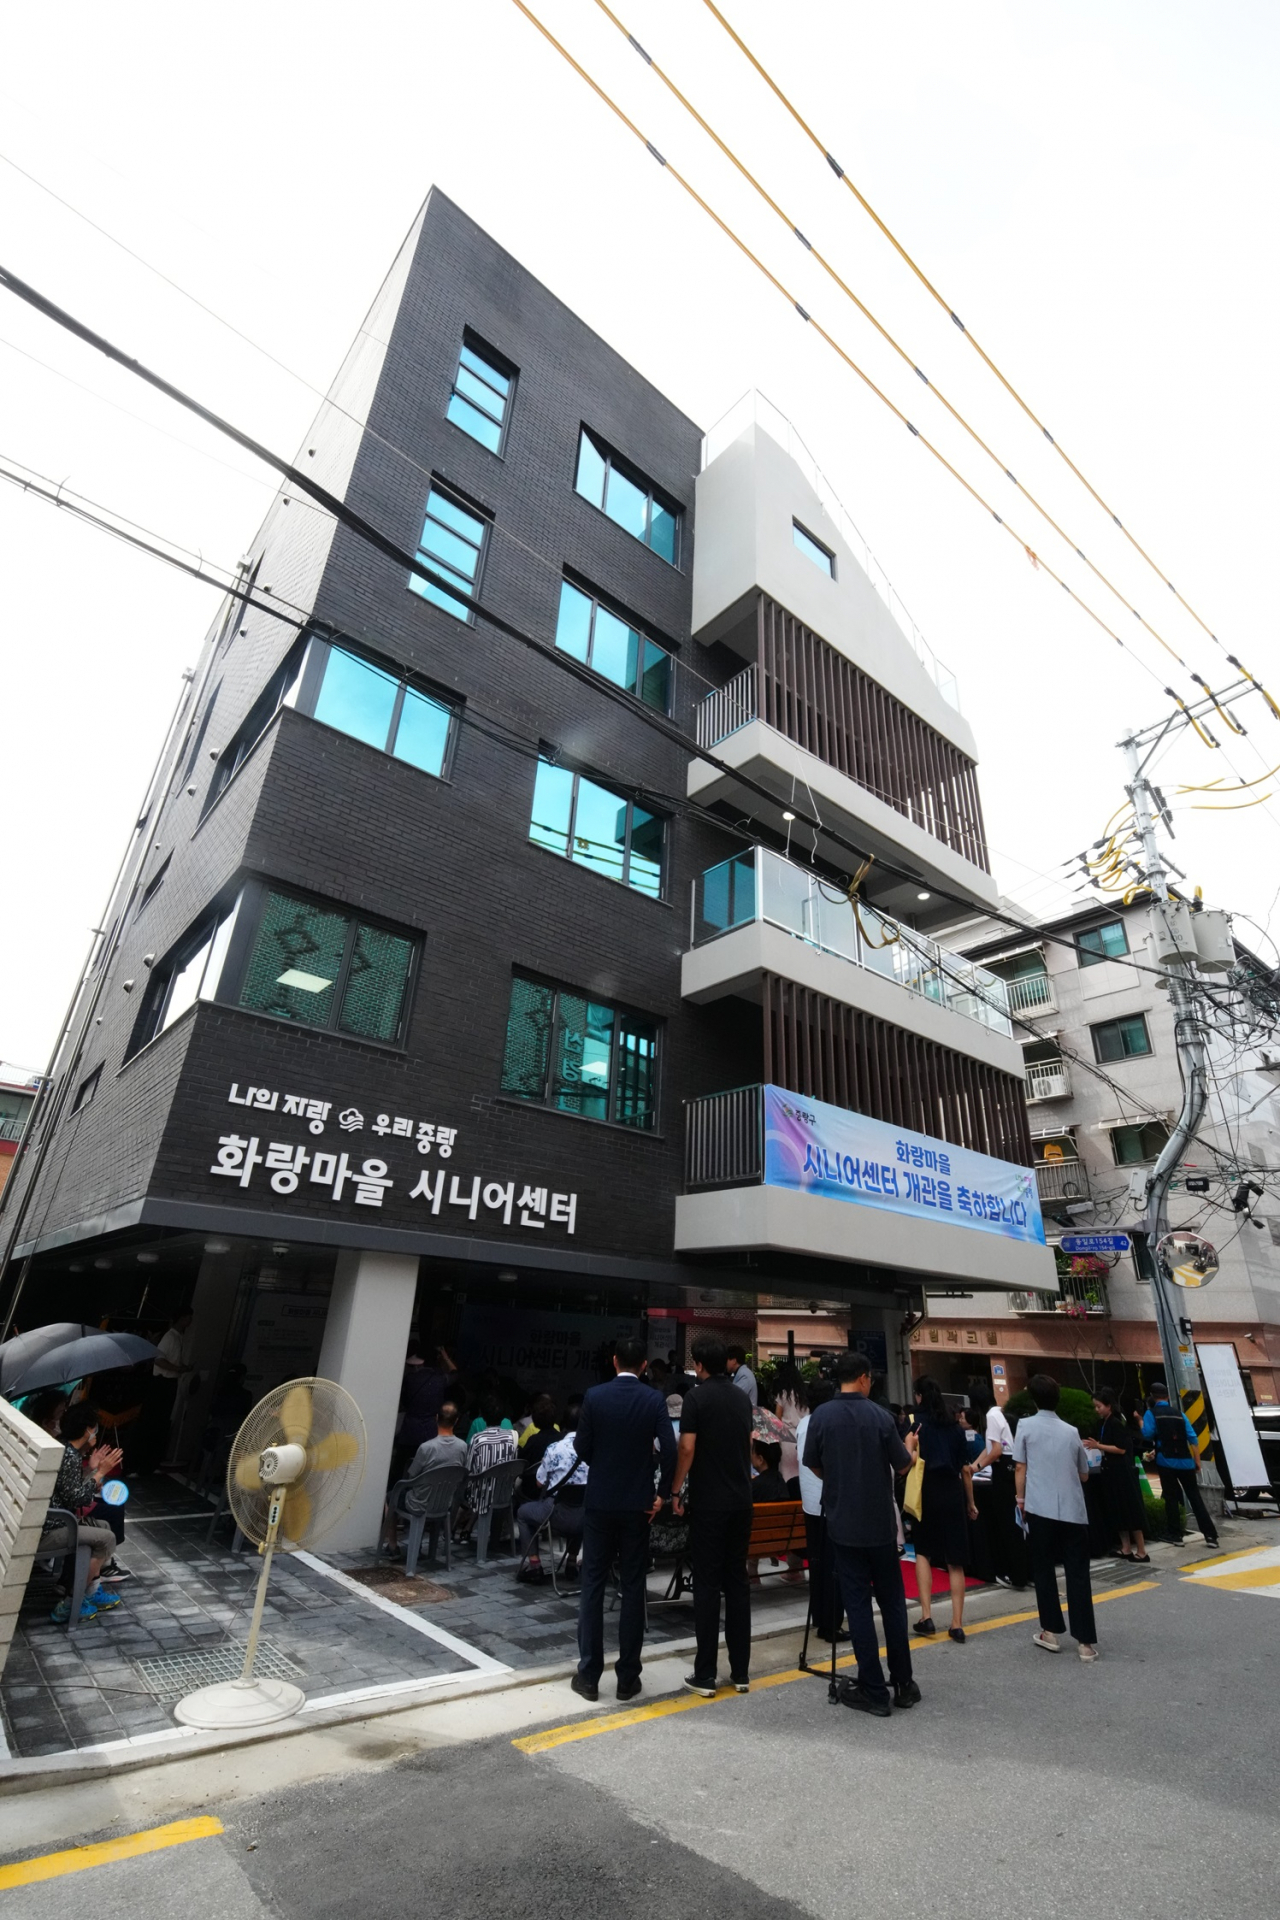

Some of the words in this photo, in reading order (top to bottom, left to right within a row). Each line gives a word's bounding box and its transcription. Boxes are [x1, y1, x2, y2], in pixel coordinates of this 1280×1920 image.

[227, 1083, 279, 1111] 나의
[281, 1093, 333, 1135] 자랑
[795, 1109, 816, 1126] 중랑구
[371, 1113, 413, 1138] 우리
[415, 1121, 458, 1158] 중랑
[895, 1139, 951, 1176] 화랑마을
[210, 1133, 394, 1207] 화랑마을
[409, 1169, 578, 1234] 시니어센터
[803, 1143, 899, 1198] 시니어센터
[902, 1171, 953, 1212] 개관을
[956, 1185, 1027, 1228] 축하합니다
[1075, 1237, 1114, 1246] 동일로154길
